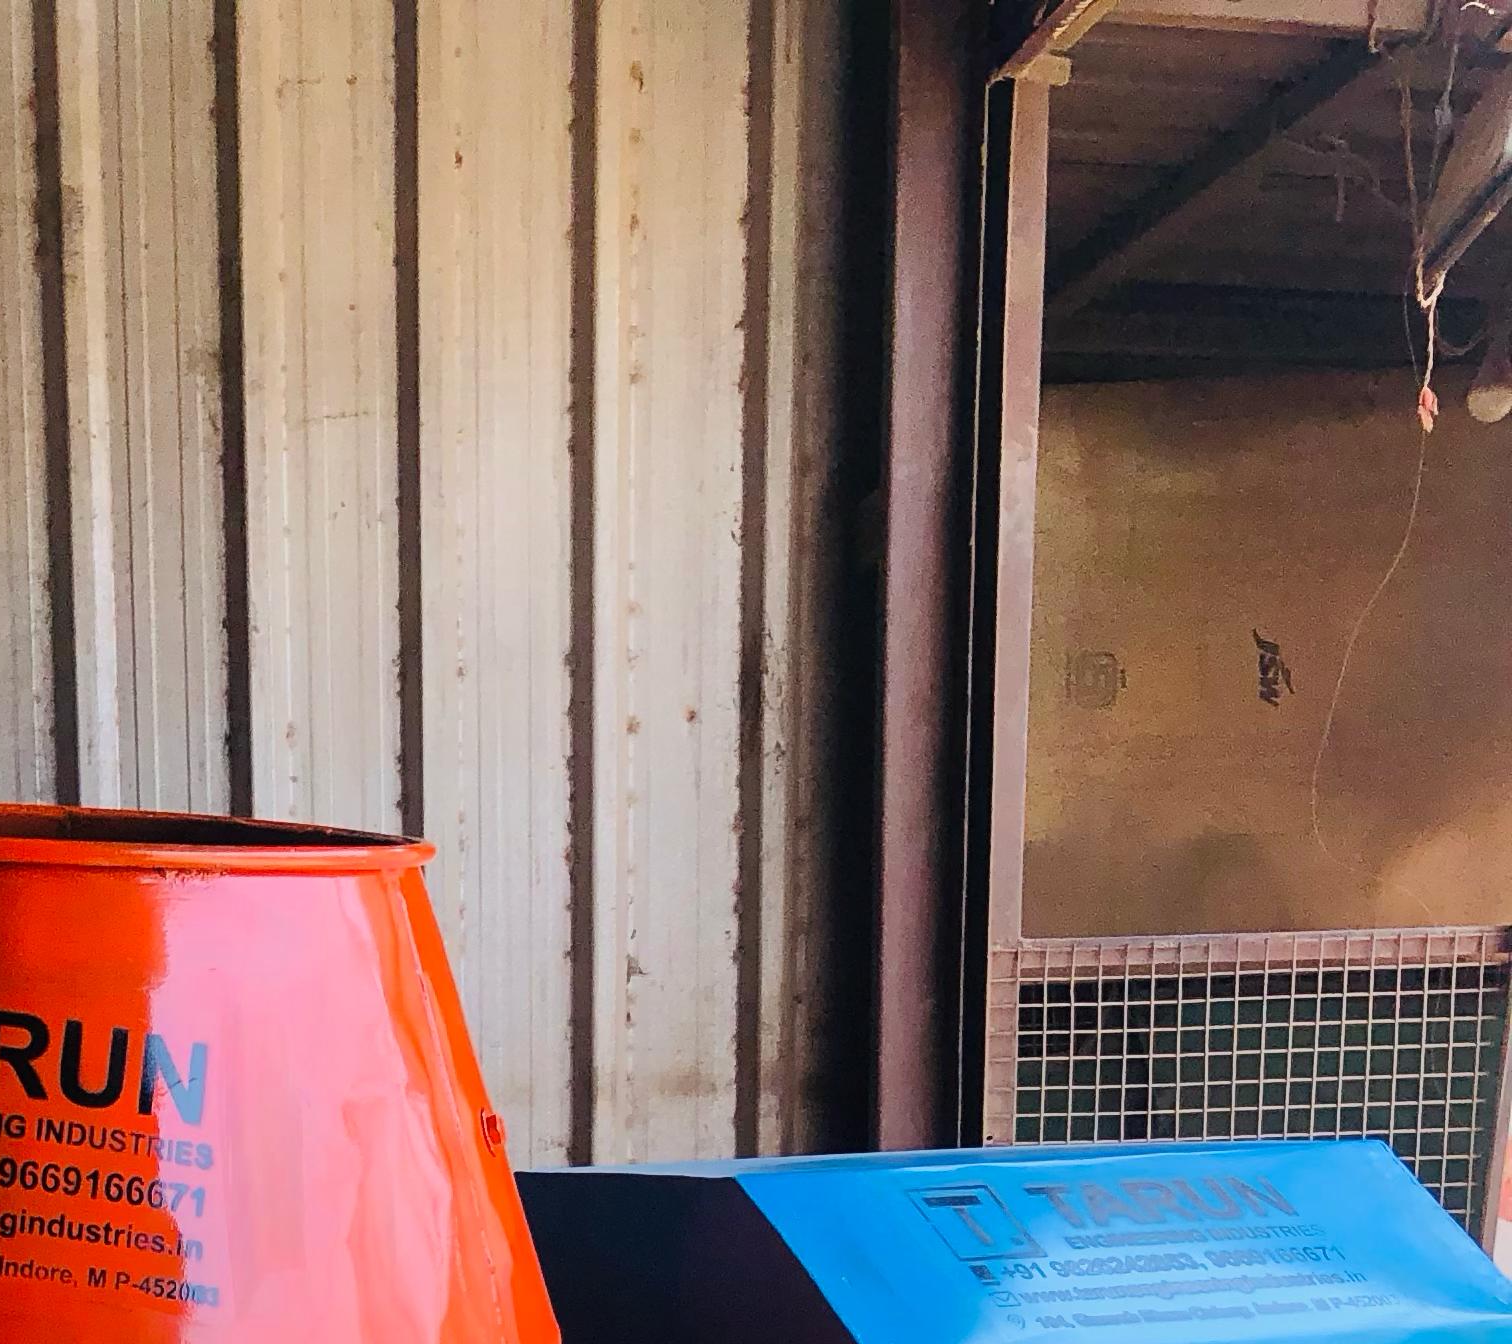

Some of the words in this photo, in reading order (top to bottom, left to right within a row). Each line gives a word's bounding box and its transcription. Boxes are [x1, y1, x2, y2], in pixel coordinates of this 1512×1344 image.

[35, 1117, 214, 1170] INDUSTRIES
[1023, 1176, 1300, 1229] TARUN
[88, 1267, 107, 1288] M
[1002, 1261, 1047, 1280] +91
